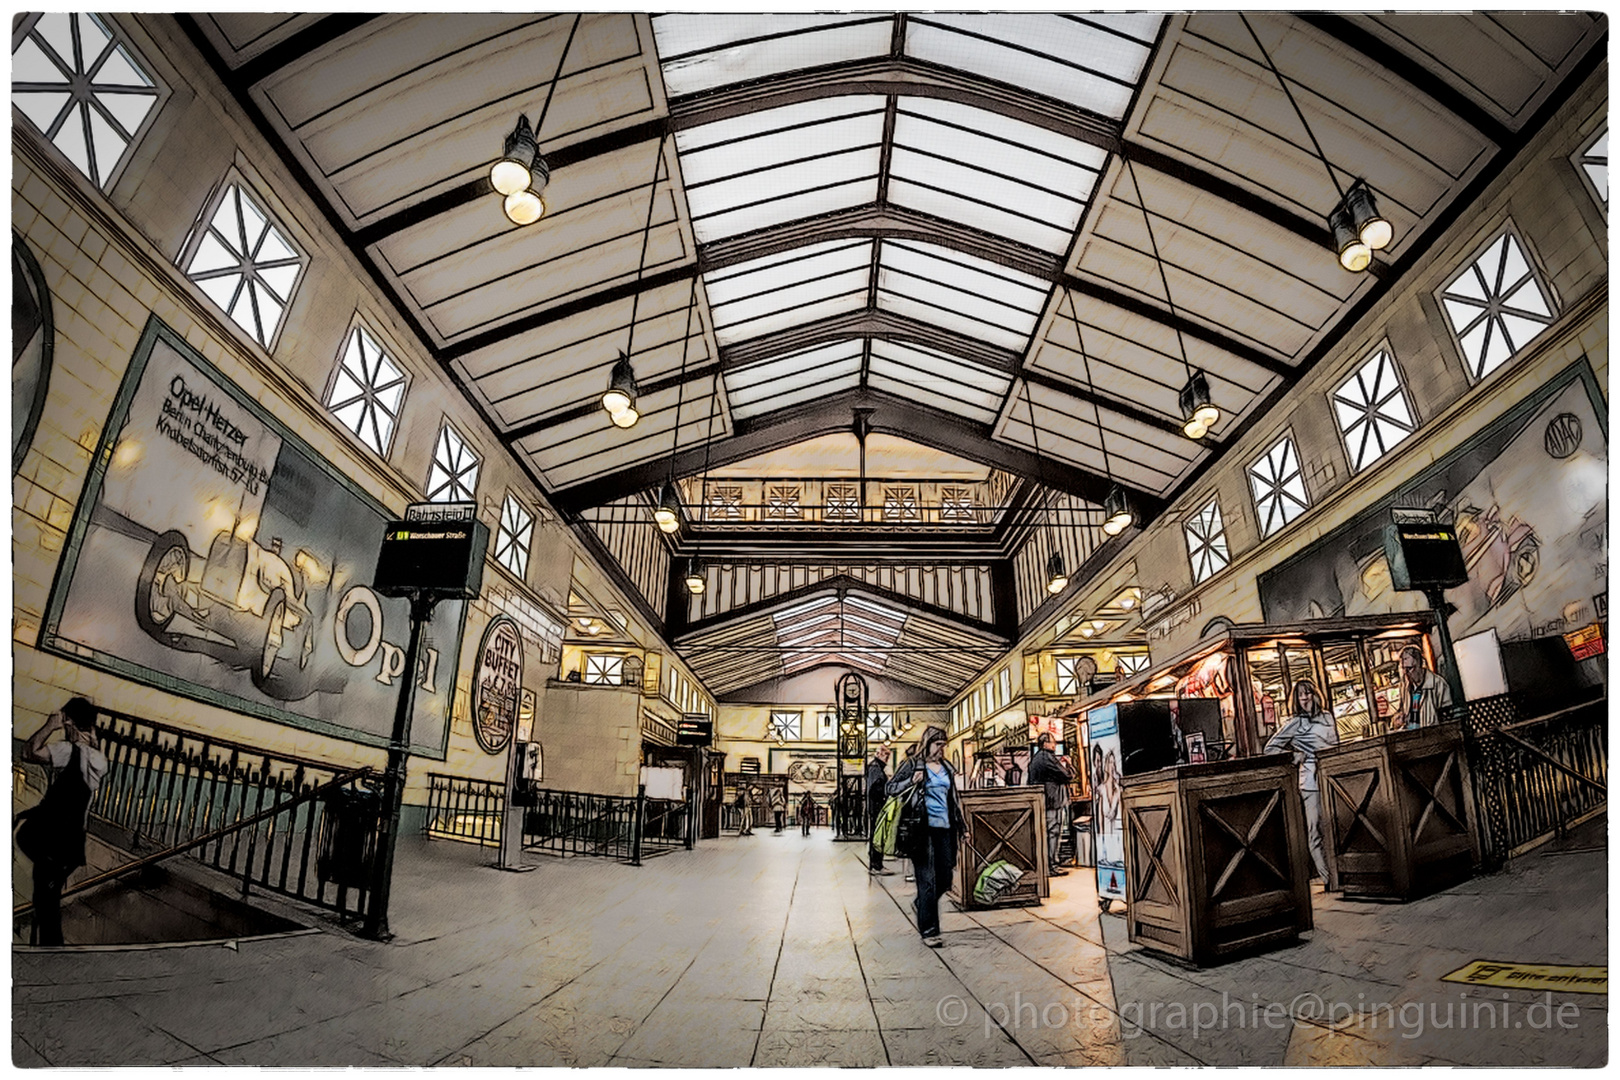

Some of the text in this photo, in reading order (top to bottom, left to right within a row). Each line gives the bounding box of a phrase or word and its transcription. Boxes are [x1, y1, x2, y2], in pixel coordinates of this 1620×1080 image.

[410, 532, 445, 540] Warschauer
[445, 531, 467, 540] Straße
[334, 585, 439, 694] Opl
[494, 632, 517, 660] CITY
[484, 648, 520, 682] BUFFET
